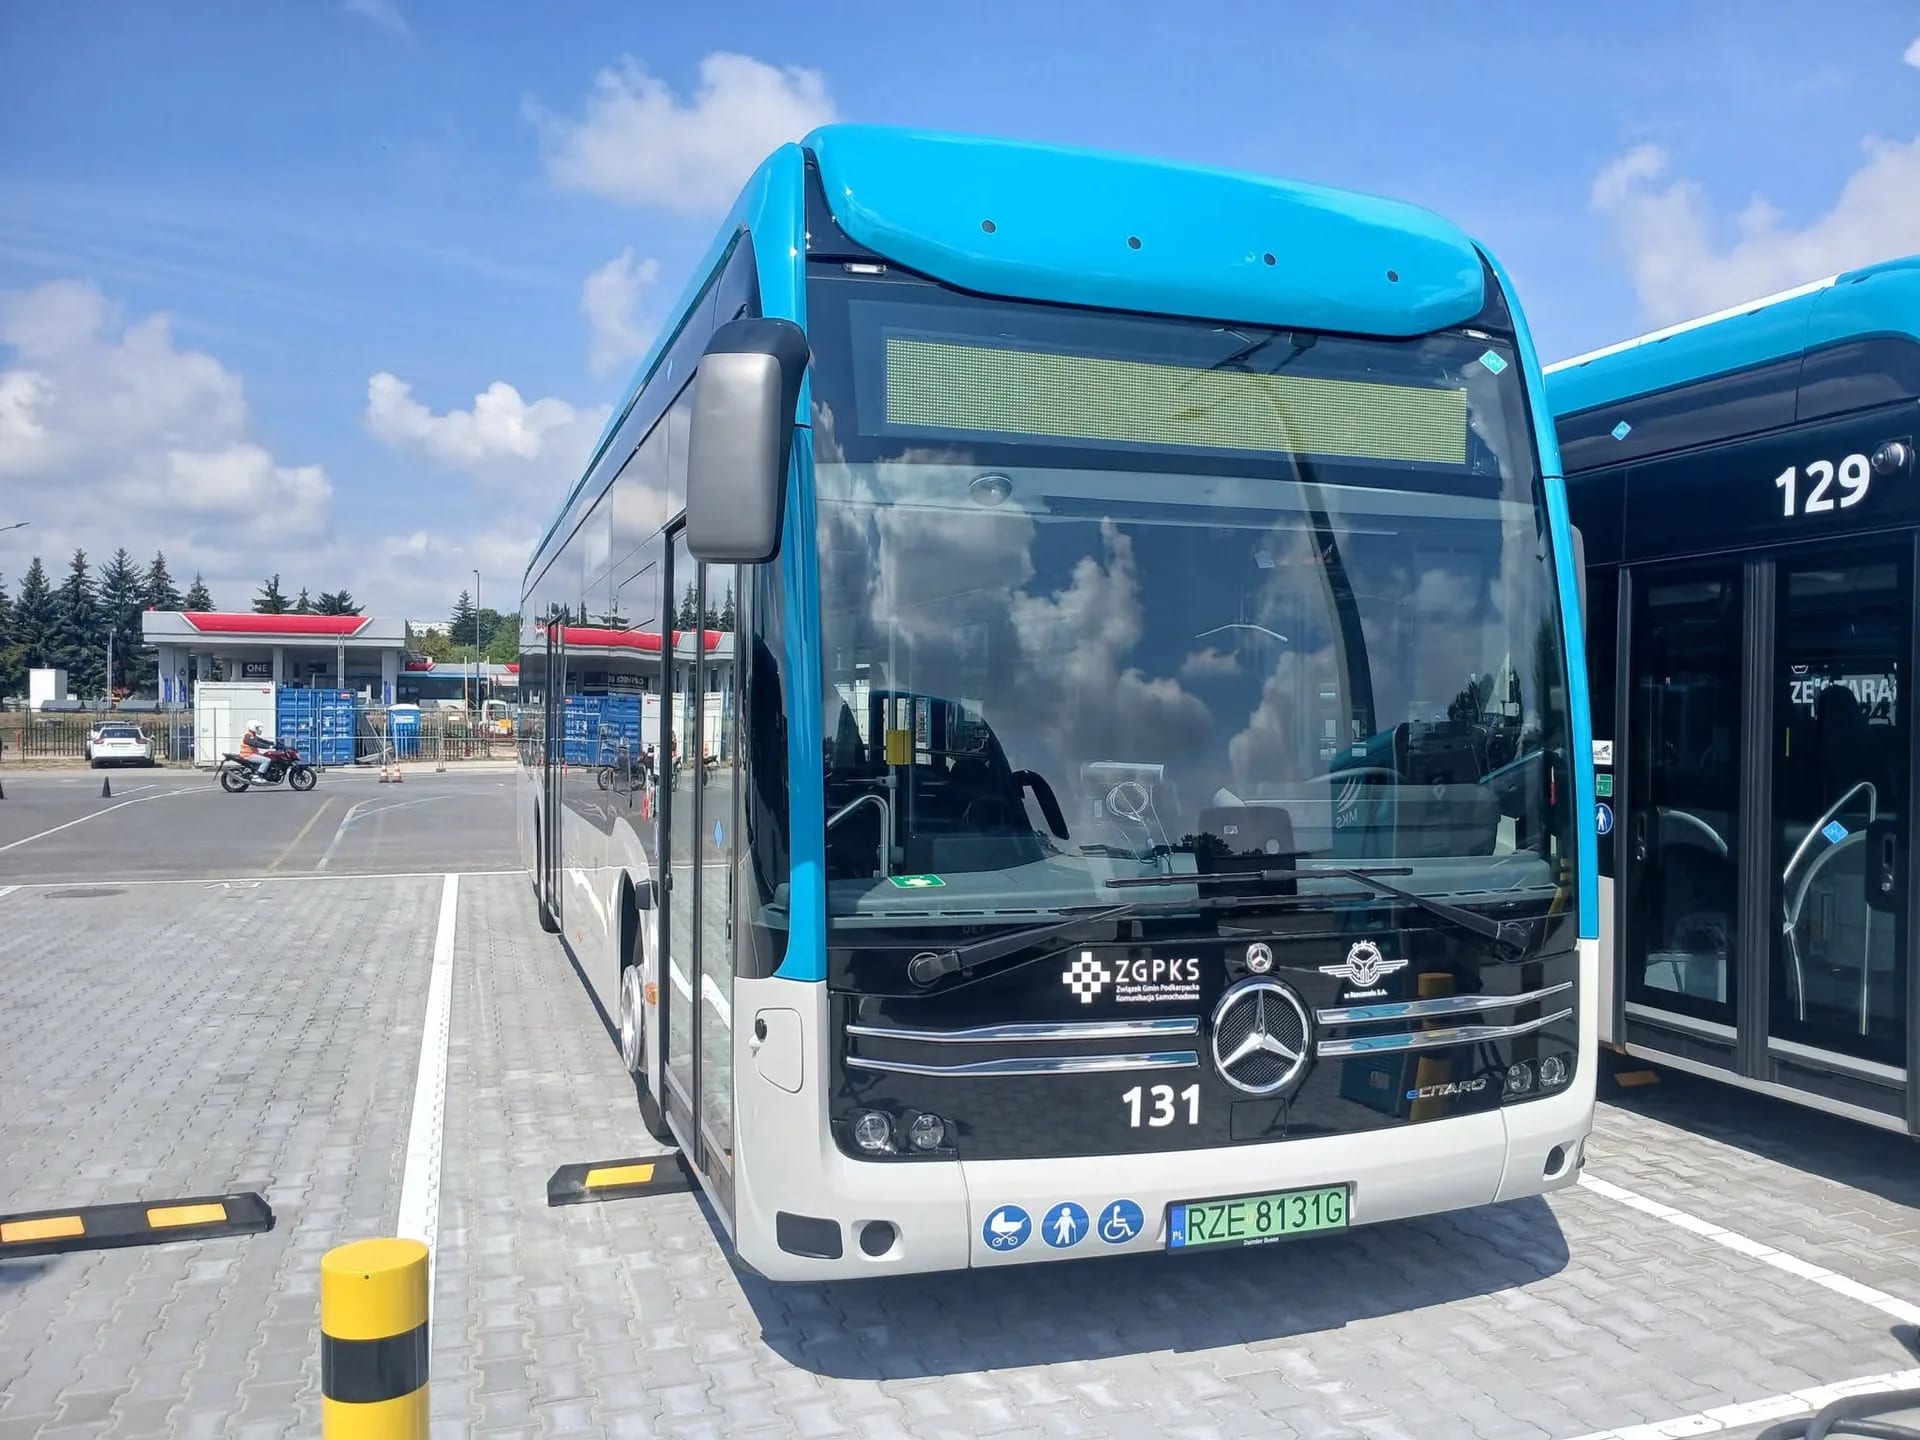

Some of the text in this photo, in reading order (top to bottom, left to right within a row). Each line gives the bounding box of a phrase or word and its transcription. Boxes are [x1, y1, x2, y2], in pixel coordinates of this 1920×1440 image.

[1775, 453, 1870, 516] 129
[1115, 958, 1200, 983] ZGPKS
[1116, 983, 1200, 994] Związek Gmin Podkarpacka
[1116, 993, 1200, 1003] Komunikacja Samochodowa
[1122, 1084, 1200, 1128] 131
[1188, 1192, 1342, 1241] RZE 8131G
[1173, 1231, 1184, 1240] PL
